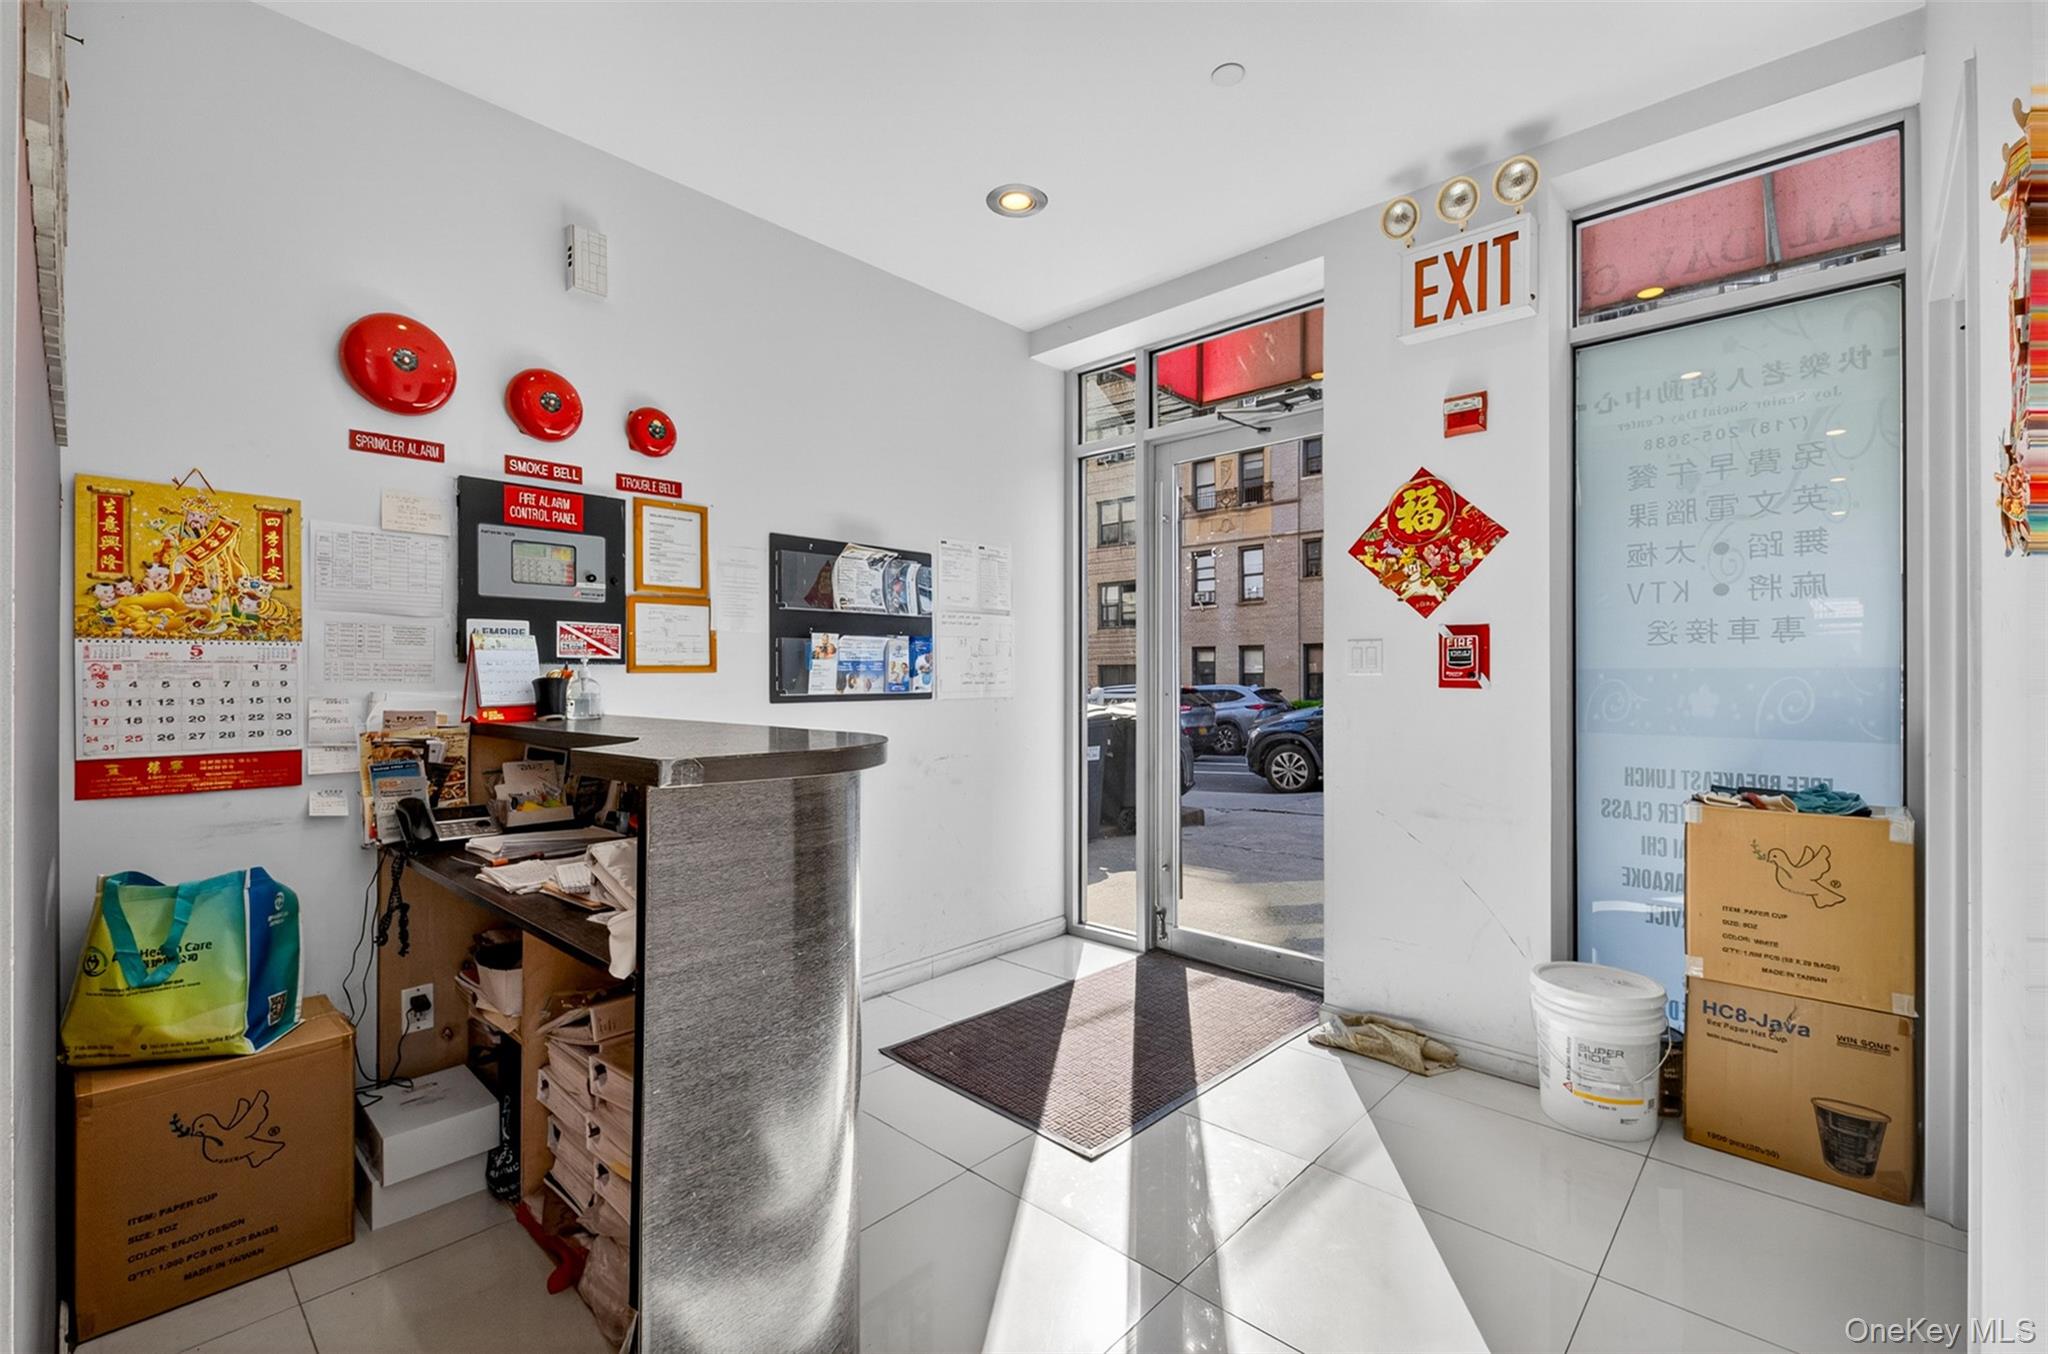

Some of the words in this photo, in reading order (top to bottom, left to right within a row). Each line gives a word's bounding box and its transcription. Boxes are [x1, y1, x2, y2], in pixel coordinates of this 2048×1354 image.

[1414, 230, 1519, 328] EXIT
[355, 434, 405, 455] SPRINKLER
[407, 442, 440, 459] ALARM
[509, 459, 548, 476] SMOKE
[553, 467, 579, 480] BELL
[621, 476, 657, 493] TROUBLE
[658, 481, 678, 495] BELL
[519, 492, 536, 505] FIRE
[539, 495, 570, 509] ALARM
[1396, 485, 1445, 533] 福
[509, 506, 550, 522] CONTROL
[552, 511, 578, 525] PANEL
[190, 645, 204, 657] 5
[91, 699, 110, 707] 10
[91, 718, 109, 726] 17
[158, 716, 174, 724] 19
[188, 715, 206, 723] 20
[219, 714, 235, 722] 21
[248, 713, 265, 721] 22
[125, 735, 143, 743] 25
[188, 732, 206, 740] 27
[219, 731, 236, 739] 28
[248, 730, 264, 738] 29
[276, 729, 293, 737] 30
[185, 941, 213, 952] Care
[1761, 967, 1783, 976] MADE
[1703, 999, 1811, 1038] HC8-Java
[1577, 1043, 1625, 1059] SUPER
[159, 1199, 194, 1217] PAPER
[196, 1192, 218, 1204] CUP
[171, 1231, 205, 1250] ENJOY
[208, 1218, 245, 1237] DESIGN
[184, 1267, 212, 1281] MADE
[227, 1247, 265, 1265] TAIWAN
